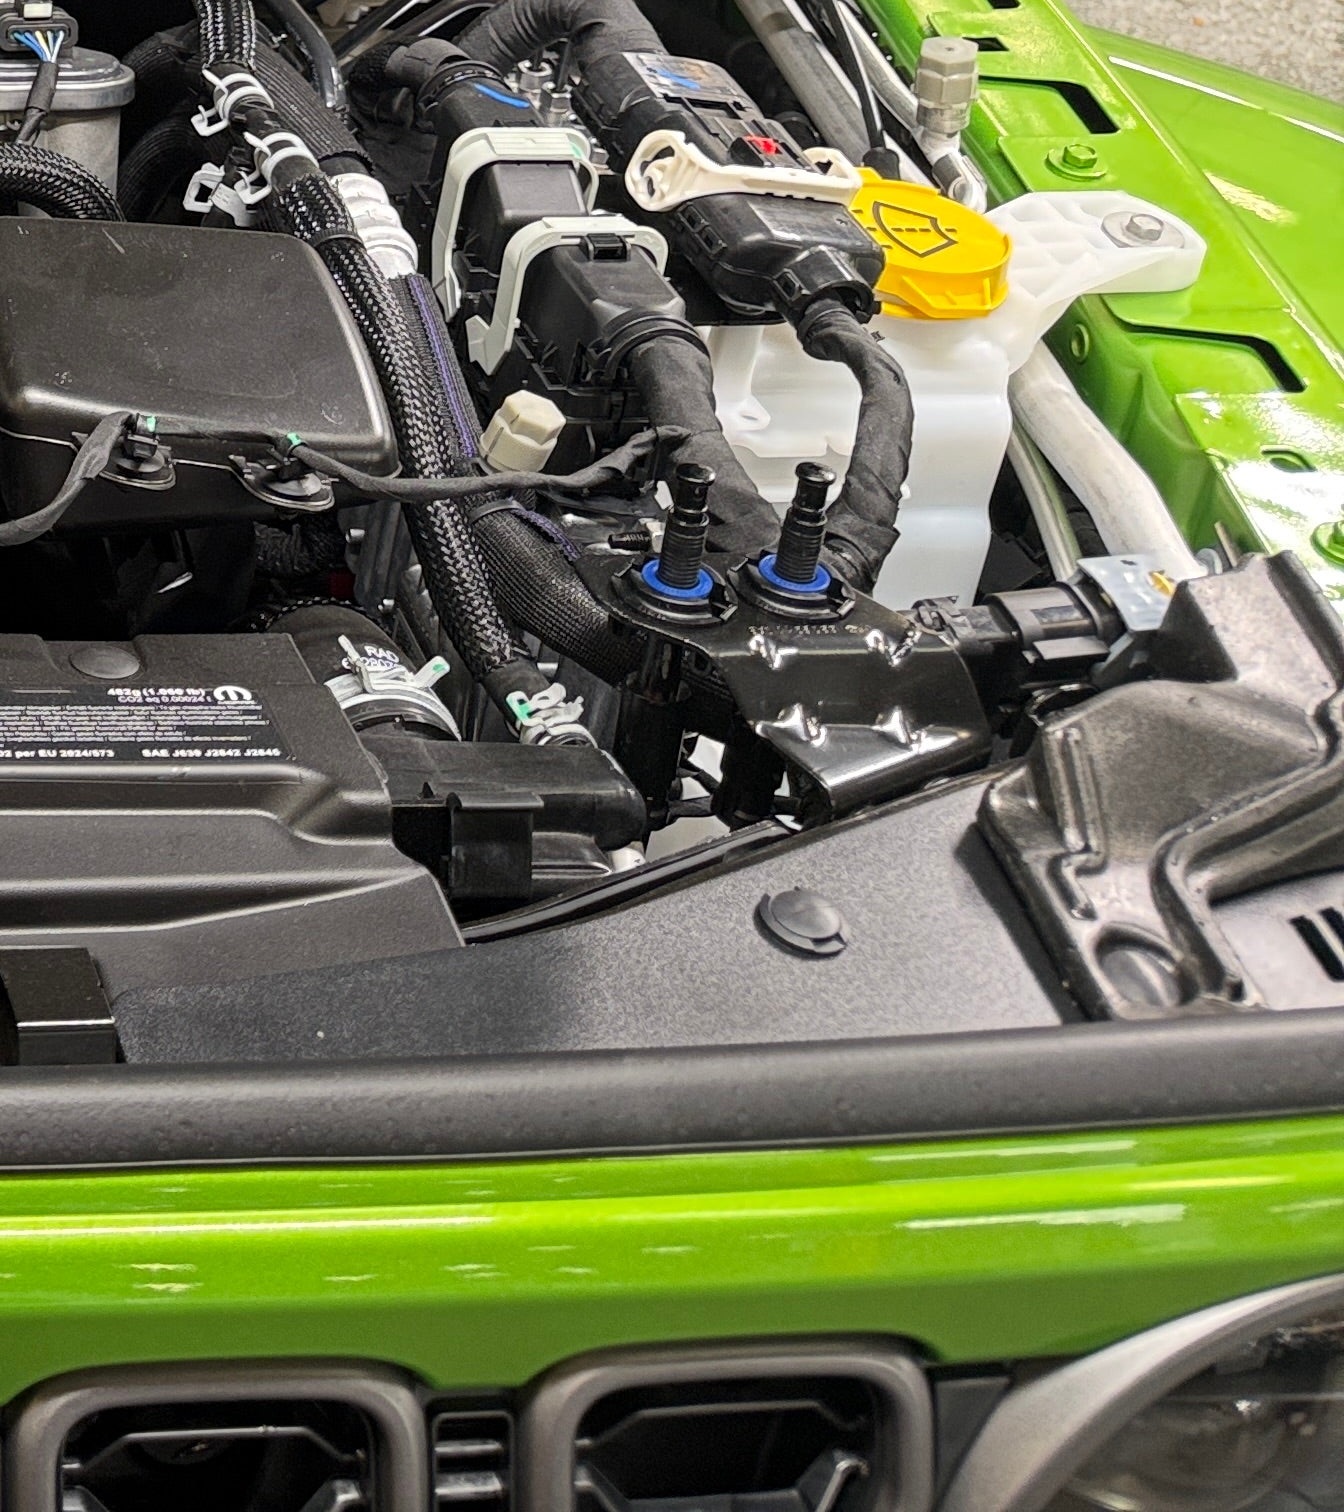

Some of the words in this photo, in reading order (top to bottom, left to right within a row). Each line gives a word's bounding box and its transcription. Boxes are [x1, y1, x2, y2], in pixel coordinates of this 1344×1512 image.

[364, 646, 399, 663] RAD
[15, 750, 36, 759] per
[38, 749, 57, 757] EU
[141, 749, 170, 757] SAE
